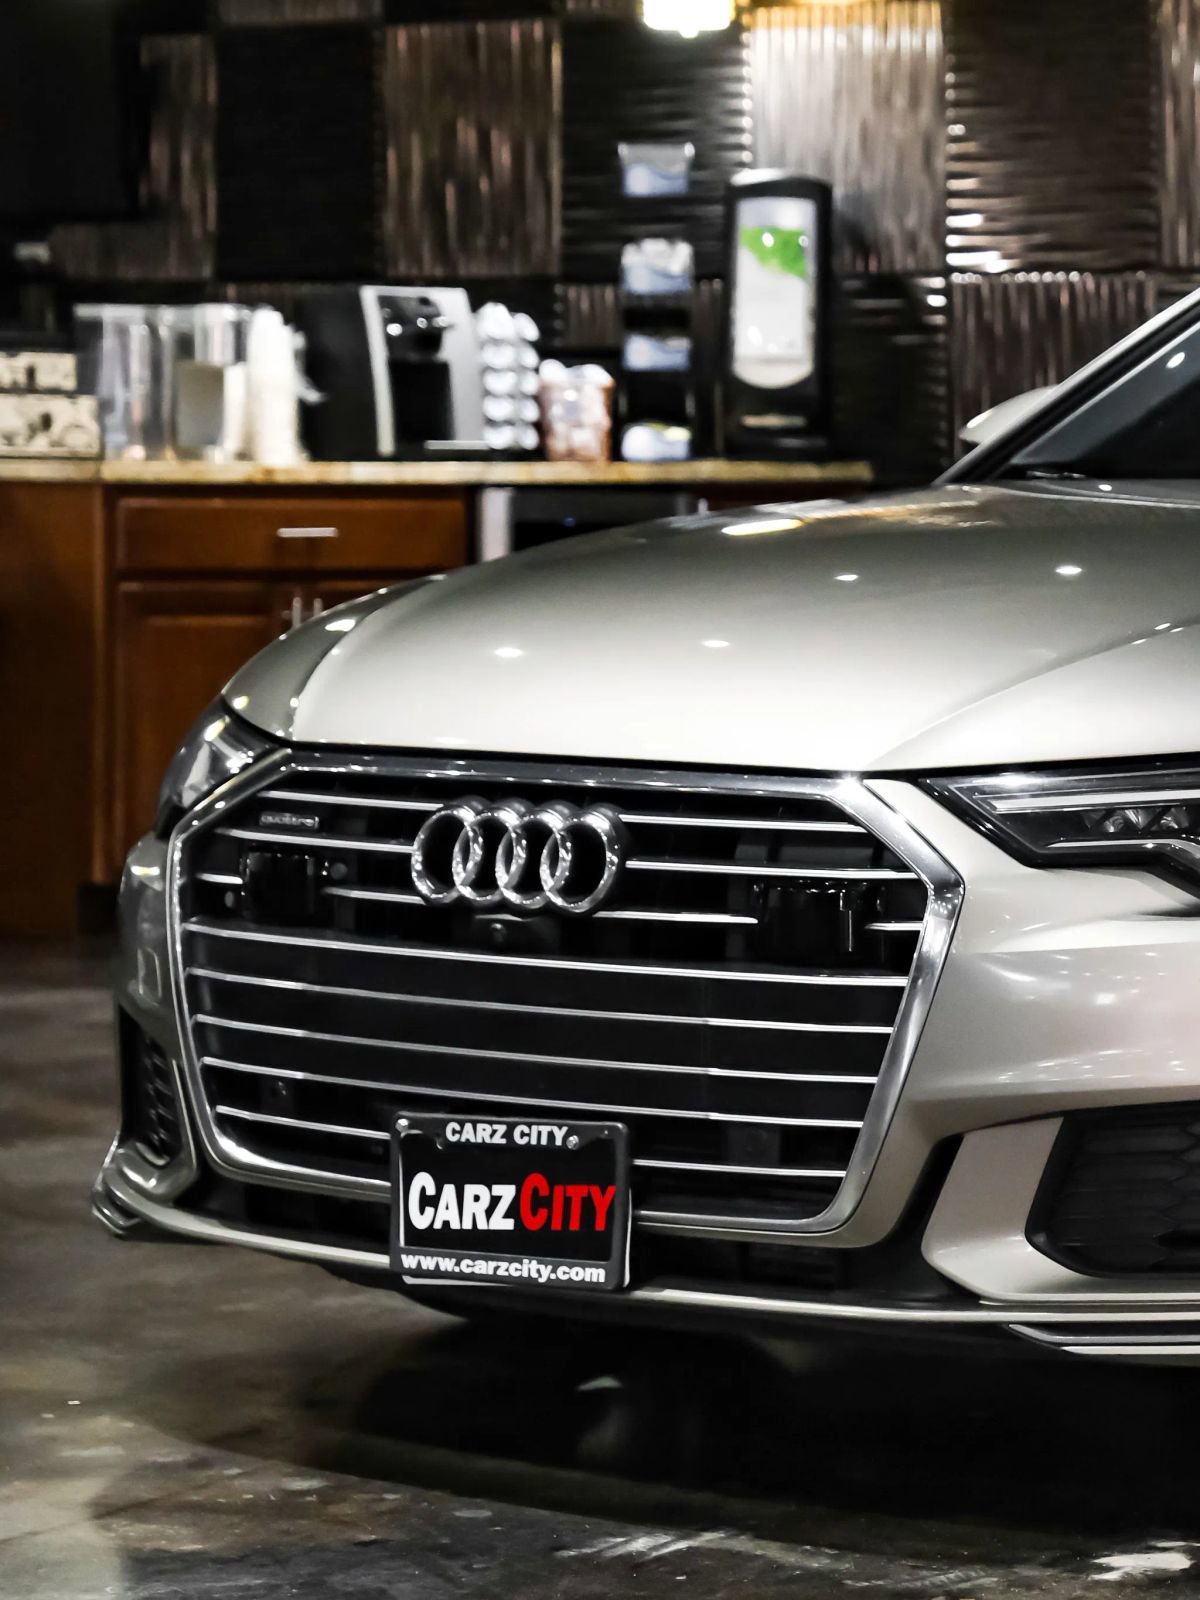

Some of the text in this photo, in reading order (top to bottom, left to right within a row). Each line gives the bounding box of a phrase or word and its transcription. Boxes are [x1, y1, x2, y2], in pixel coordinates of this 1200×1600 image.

[445, 1121, 568, 1146] CARZ CITY
[401, 1254, 606, 1283] www.carzcity.com
